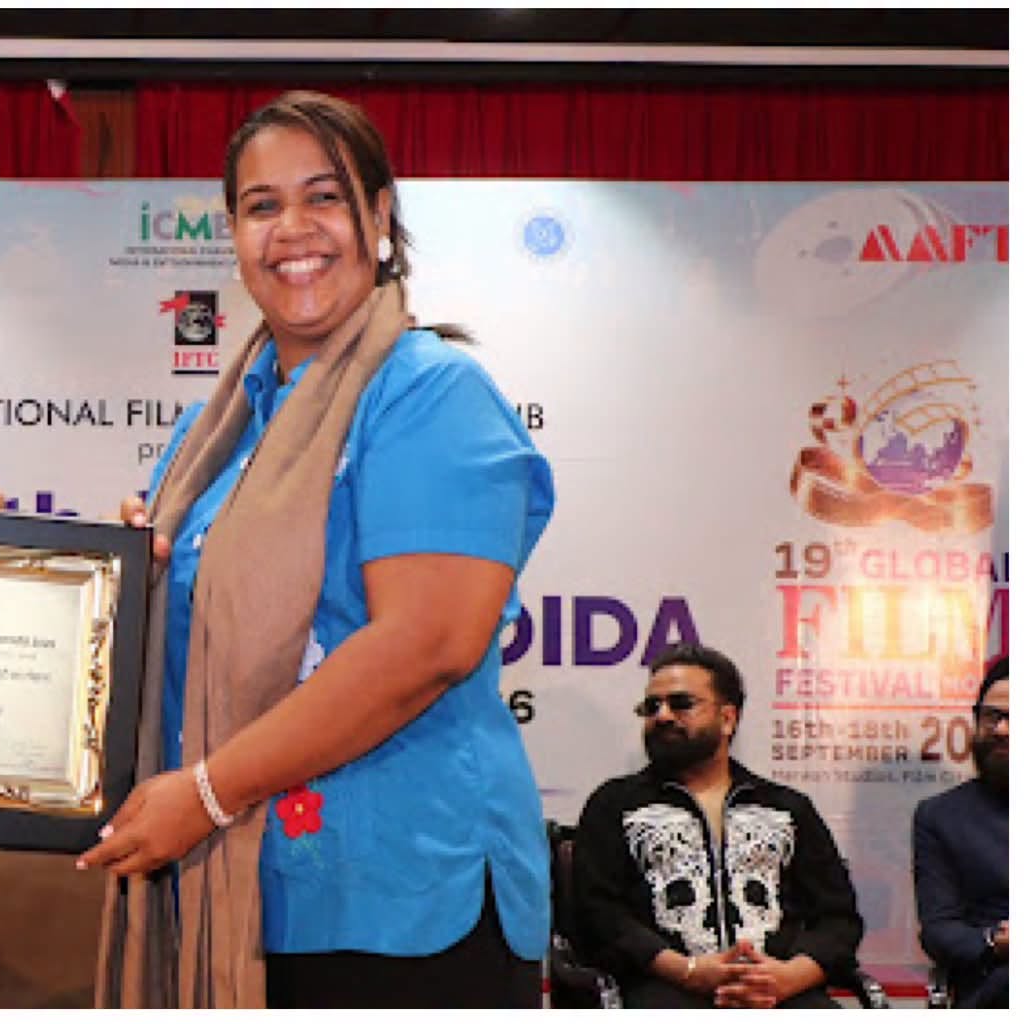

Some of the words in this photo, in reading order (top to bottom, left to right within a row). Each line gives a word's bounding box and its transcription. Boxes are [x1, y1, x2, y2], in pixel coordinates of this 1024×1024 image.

[173, 352, 219, 368] IFTC
[775, 669, 933, 697] FESTIVAL
[771, 719, 911, 739] 16th-18th
[771, 744, 908, 761] SEPTEMBER
